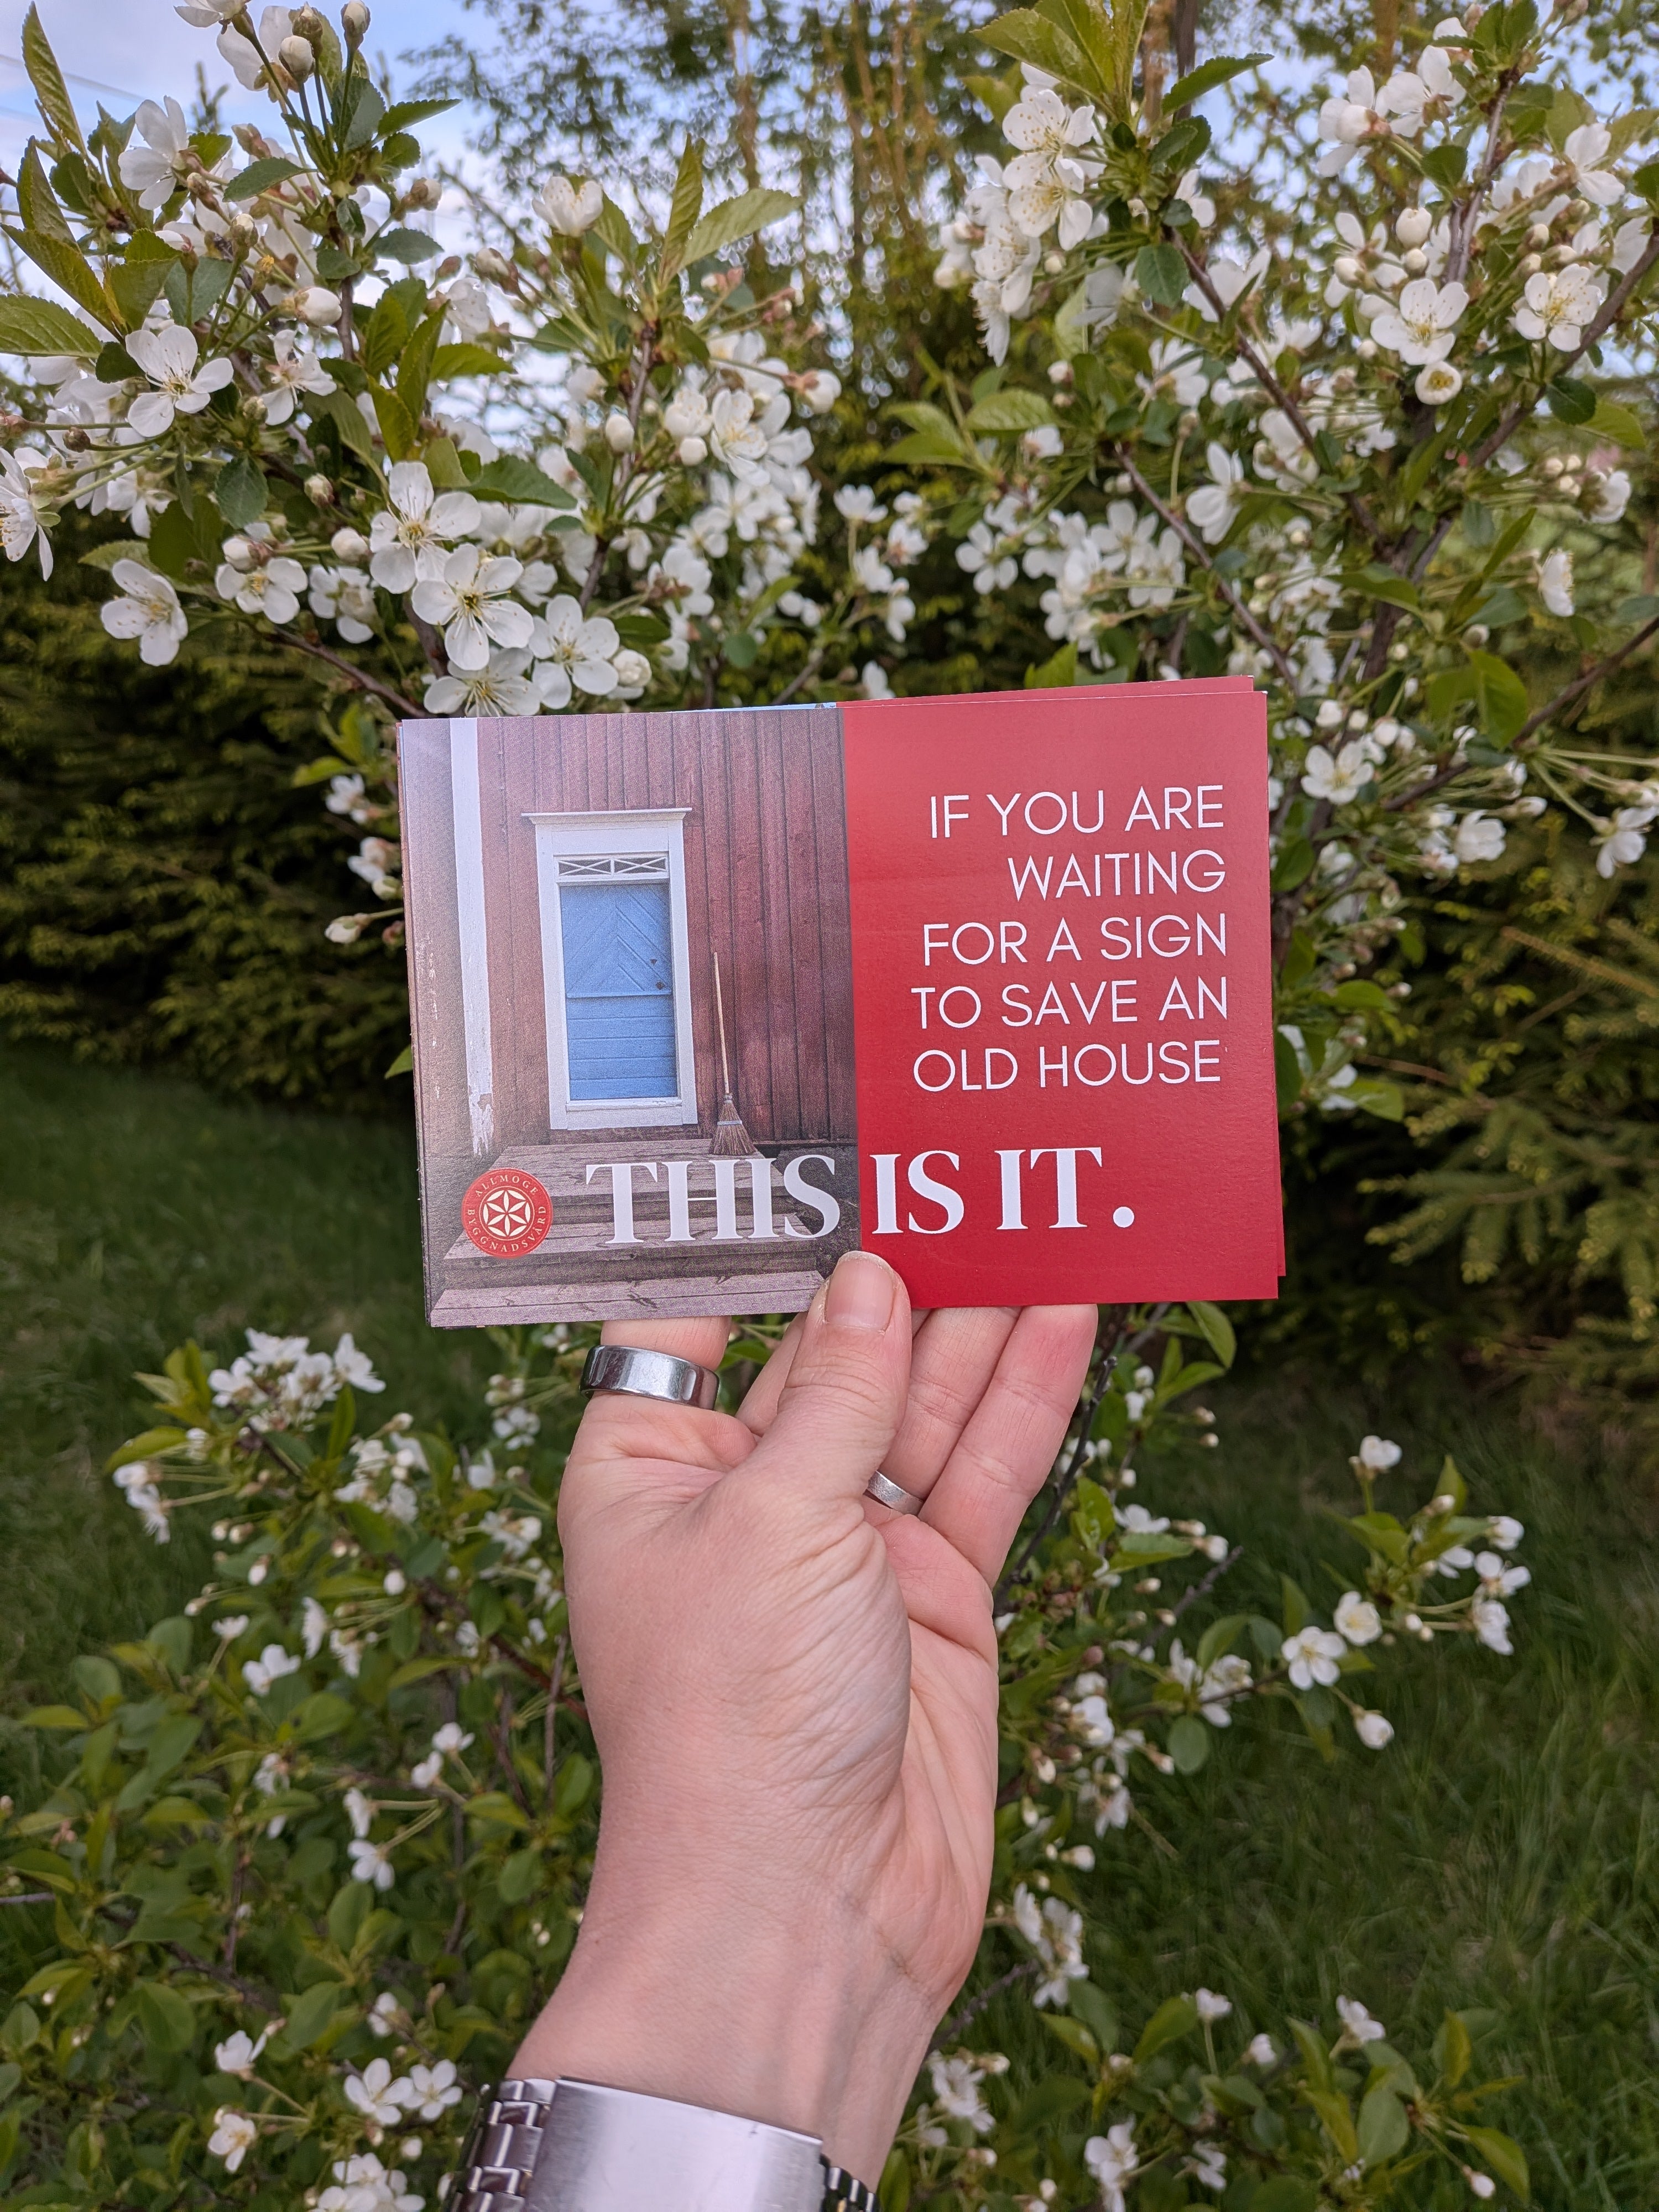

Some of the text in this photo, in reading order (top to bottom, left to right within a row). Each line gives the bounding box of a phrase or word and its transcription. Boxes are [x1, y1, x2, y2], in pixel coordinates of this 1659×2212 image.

[931, 785, 1223, 838] IF YOU ARE
[1008, 850, 1225, 900] WAITING
[924, 913, 1225, 966] FOR A SIGN
[911, 977, 1227, 1029] TO SAVE AN
[914, 1040, 1220, 1091] OLD HOUSE
[475, 1174, 539, 1198] ALLMOGE
[585, 1153, 841, 1245] THIS
[870, 1151, 964, 1234] IS
[467, 1206, 546, 1253] BYGGNADSVÅRD
